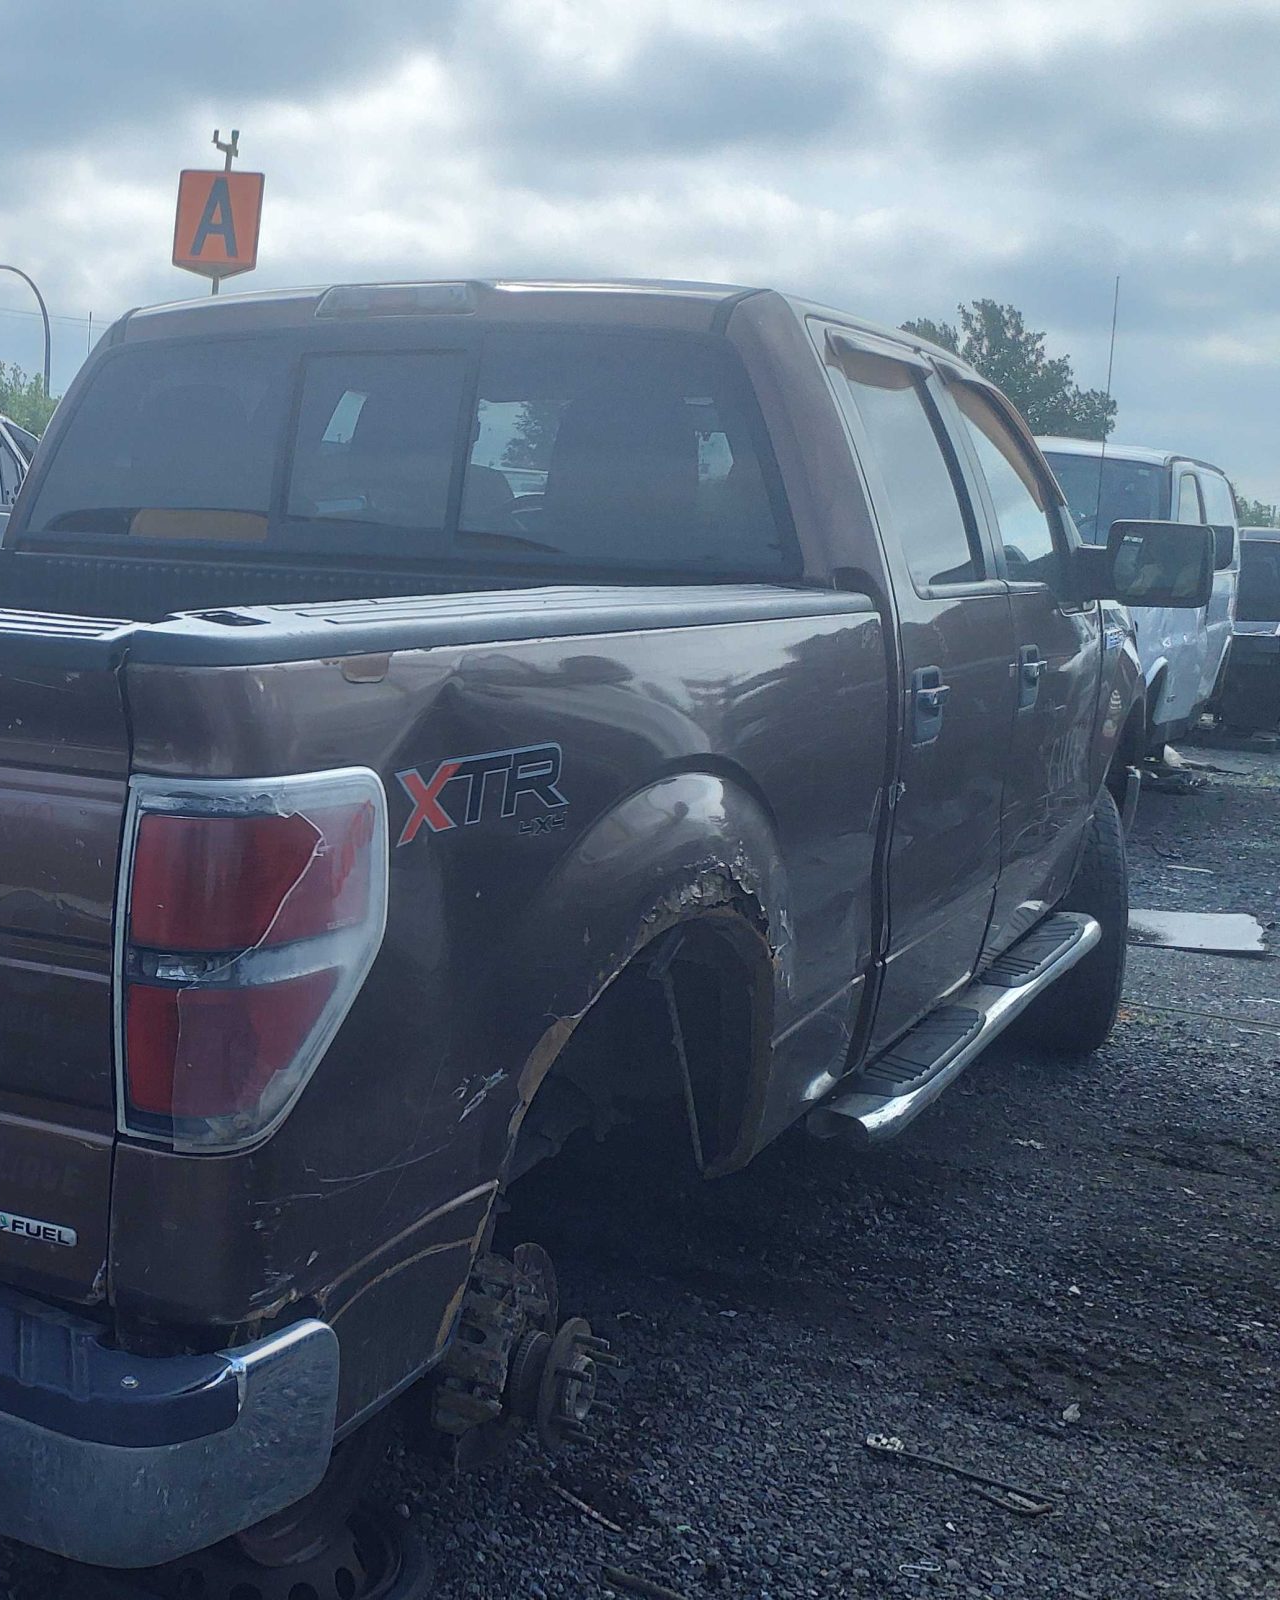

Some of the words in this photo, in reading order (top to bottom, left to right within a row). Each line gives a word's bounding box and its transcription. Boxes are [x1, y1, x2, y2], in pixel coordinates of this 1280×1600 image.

[189, 176, 238, 258] A
[395, 741, 570, 848] XTR
[11, 1219, 71, 1245] FUEL
